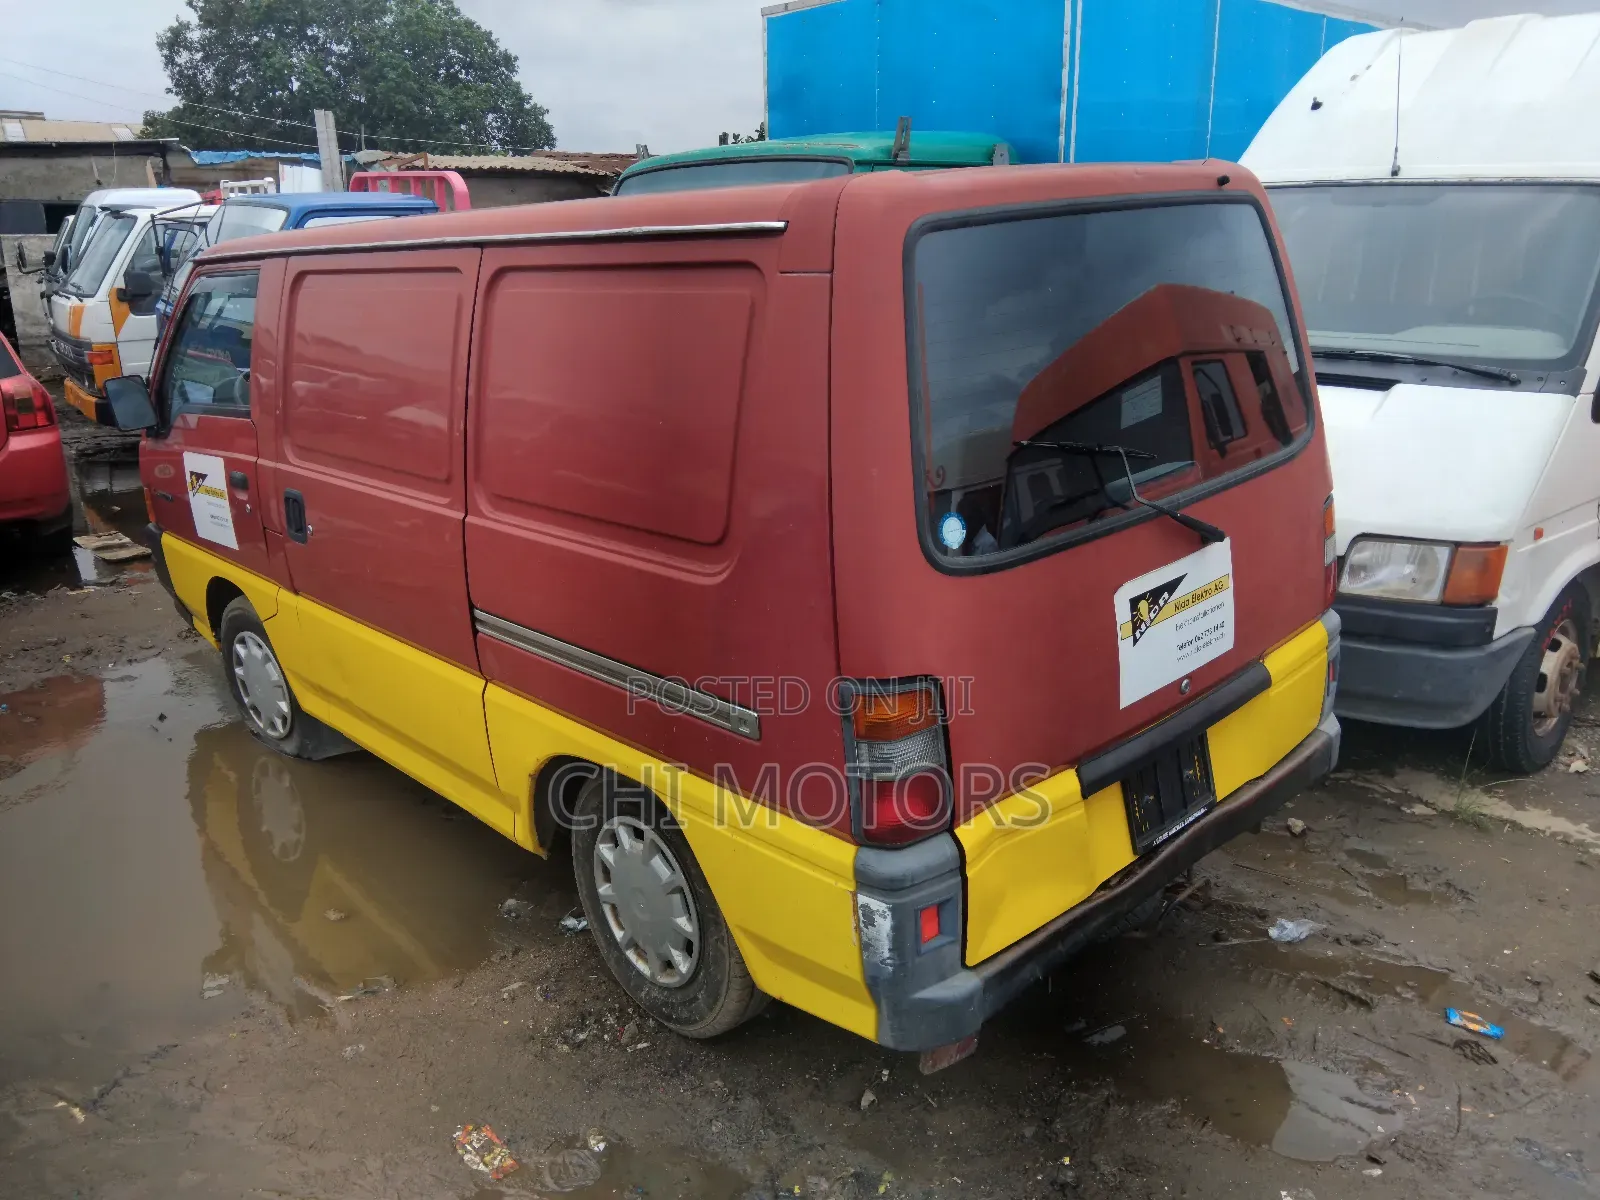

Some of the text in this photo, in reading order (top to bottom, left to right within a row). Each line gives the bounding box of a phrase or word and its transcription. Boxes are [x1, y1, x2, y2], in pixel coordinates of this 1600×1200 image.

[1174, 580, 1224, 613] Nida Elektro AG
